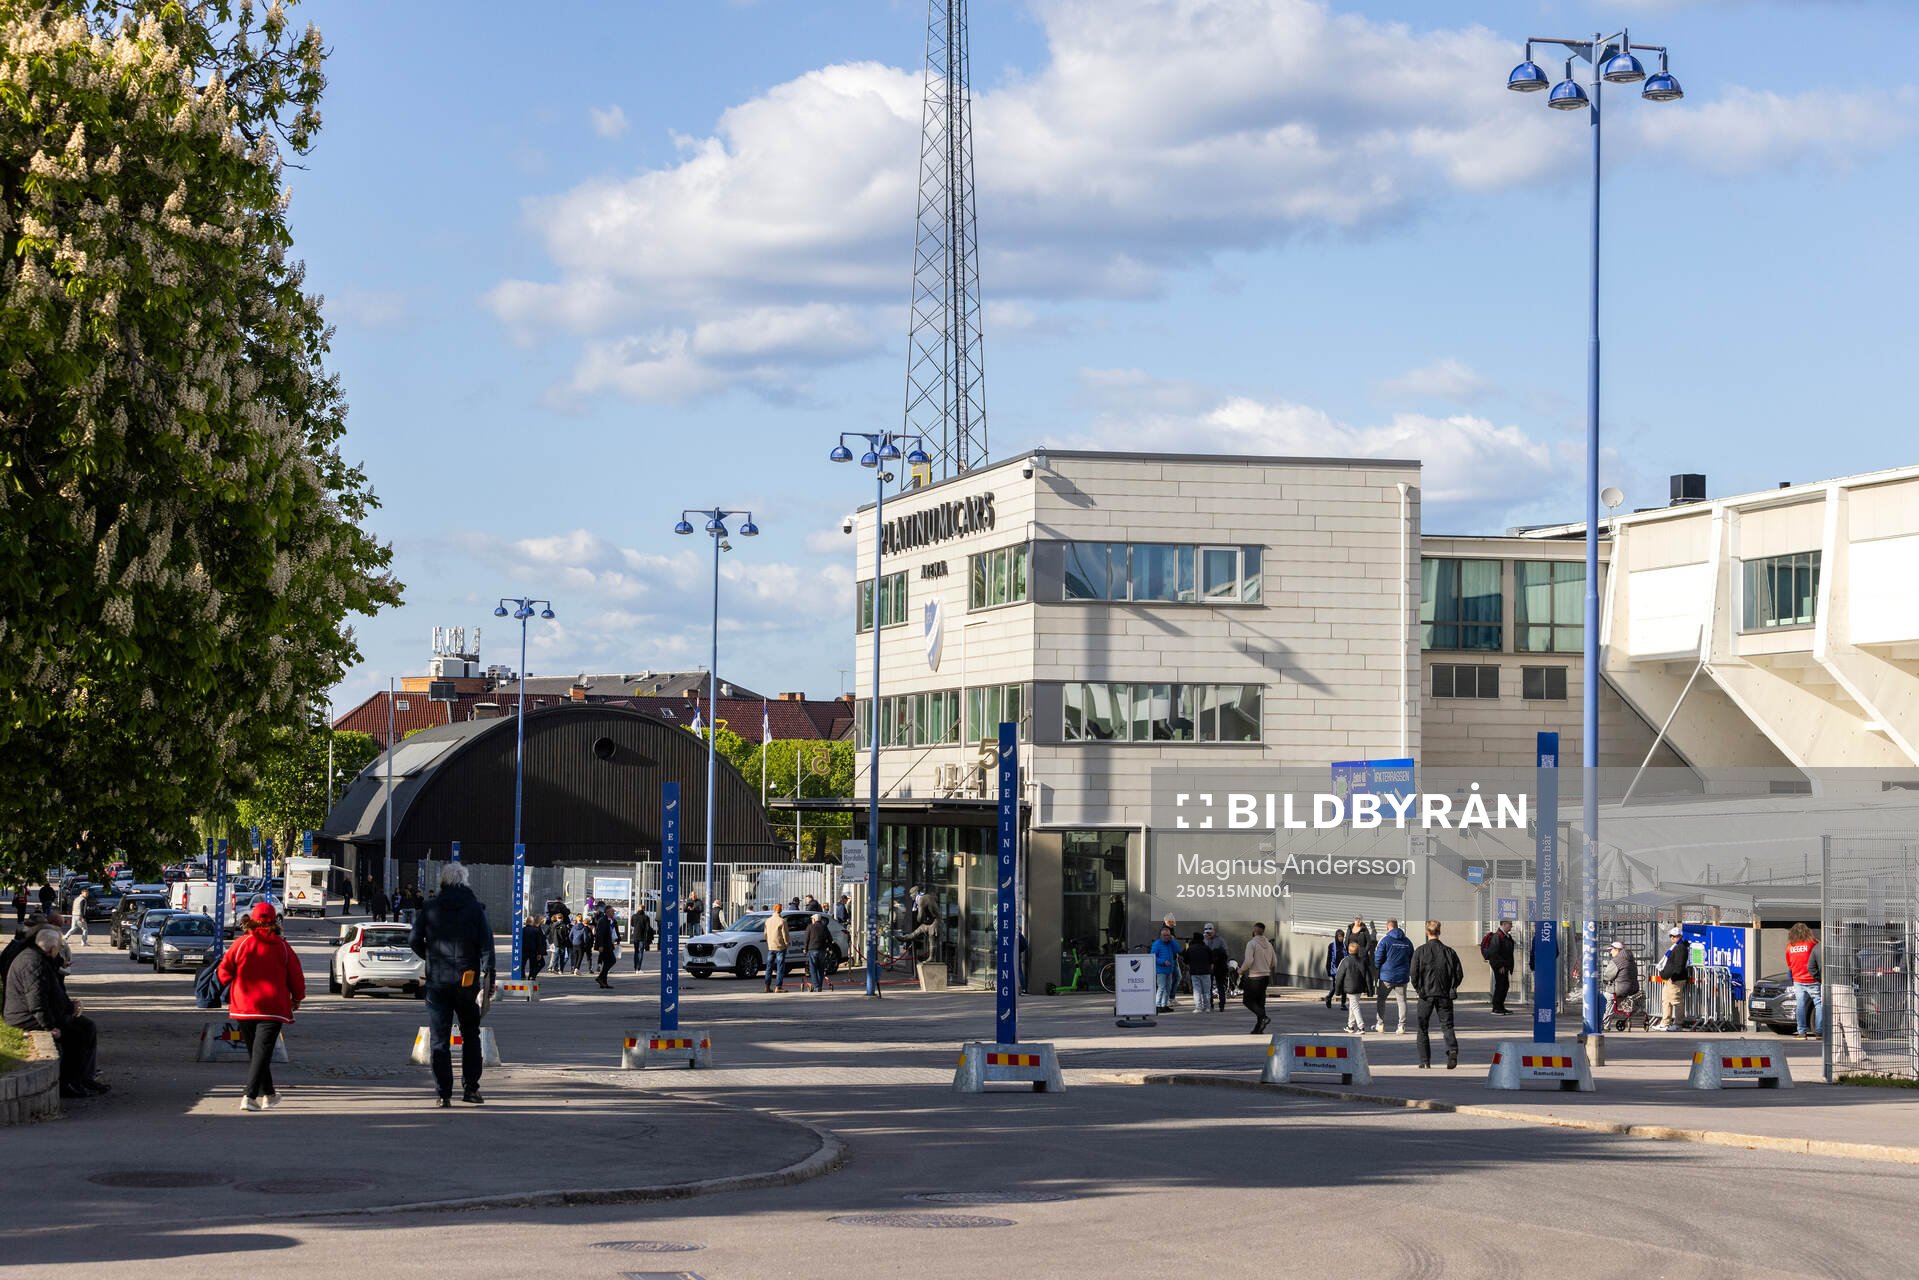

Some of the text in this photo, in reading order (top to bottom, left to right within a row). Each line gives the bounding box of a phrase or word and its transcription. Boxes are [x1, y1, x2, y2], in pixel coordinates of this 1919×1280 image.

[921, 561, 948, 579] ARENA
[978, 738, 999, 770] 5
[666, 820, 674, 893] PEKING
[1000, 772, 1011, 997] PEKING PEKING
[1541, 834, 1553, 942] Köp Halva Potten här
[1732, 948, 1742, 968] 4A
